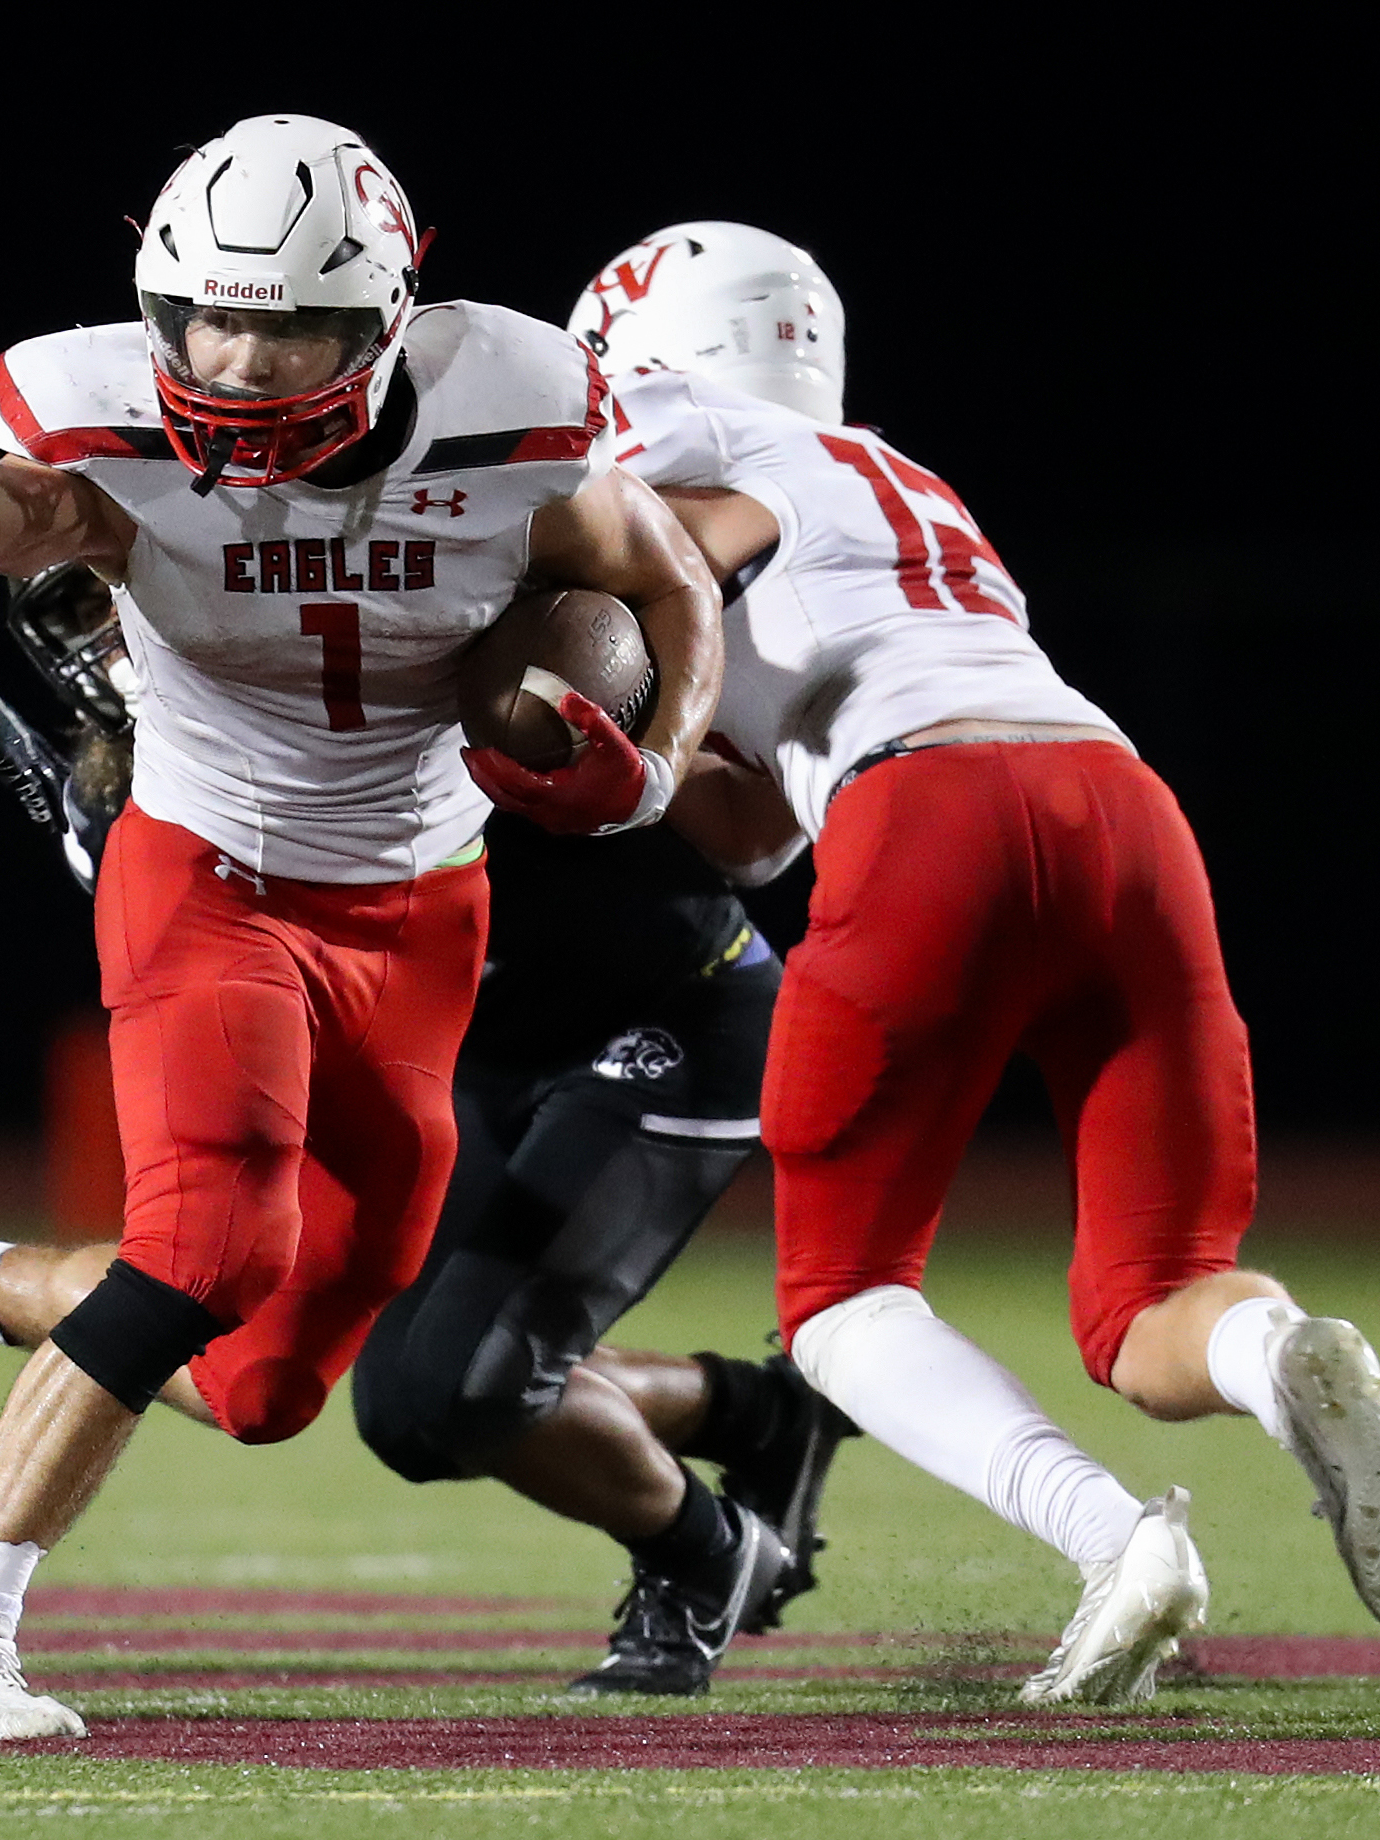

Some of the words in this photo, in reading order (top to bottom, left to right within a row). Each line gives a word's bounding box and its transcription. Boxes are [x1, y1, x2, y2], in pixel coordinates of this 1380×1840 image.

[204, 278, 284, 301] Riddell
[223, 537, 436, 593] EAGLES
[814, 432, 1021, 627] 12
[300, 602, 367, 733] 1
